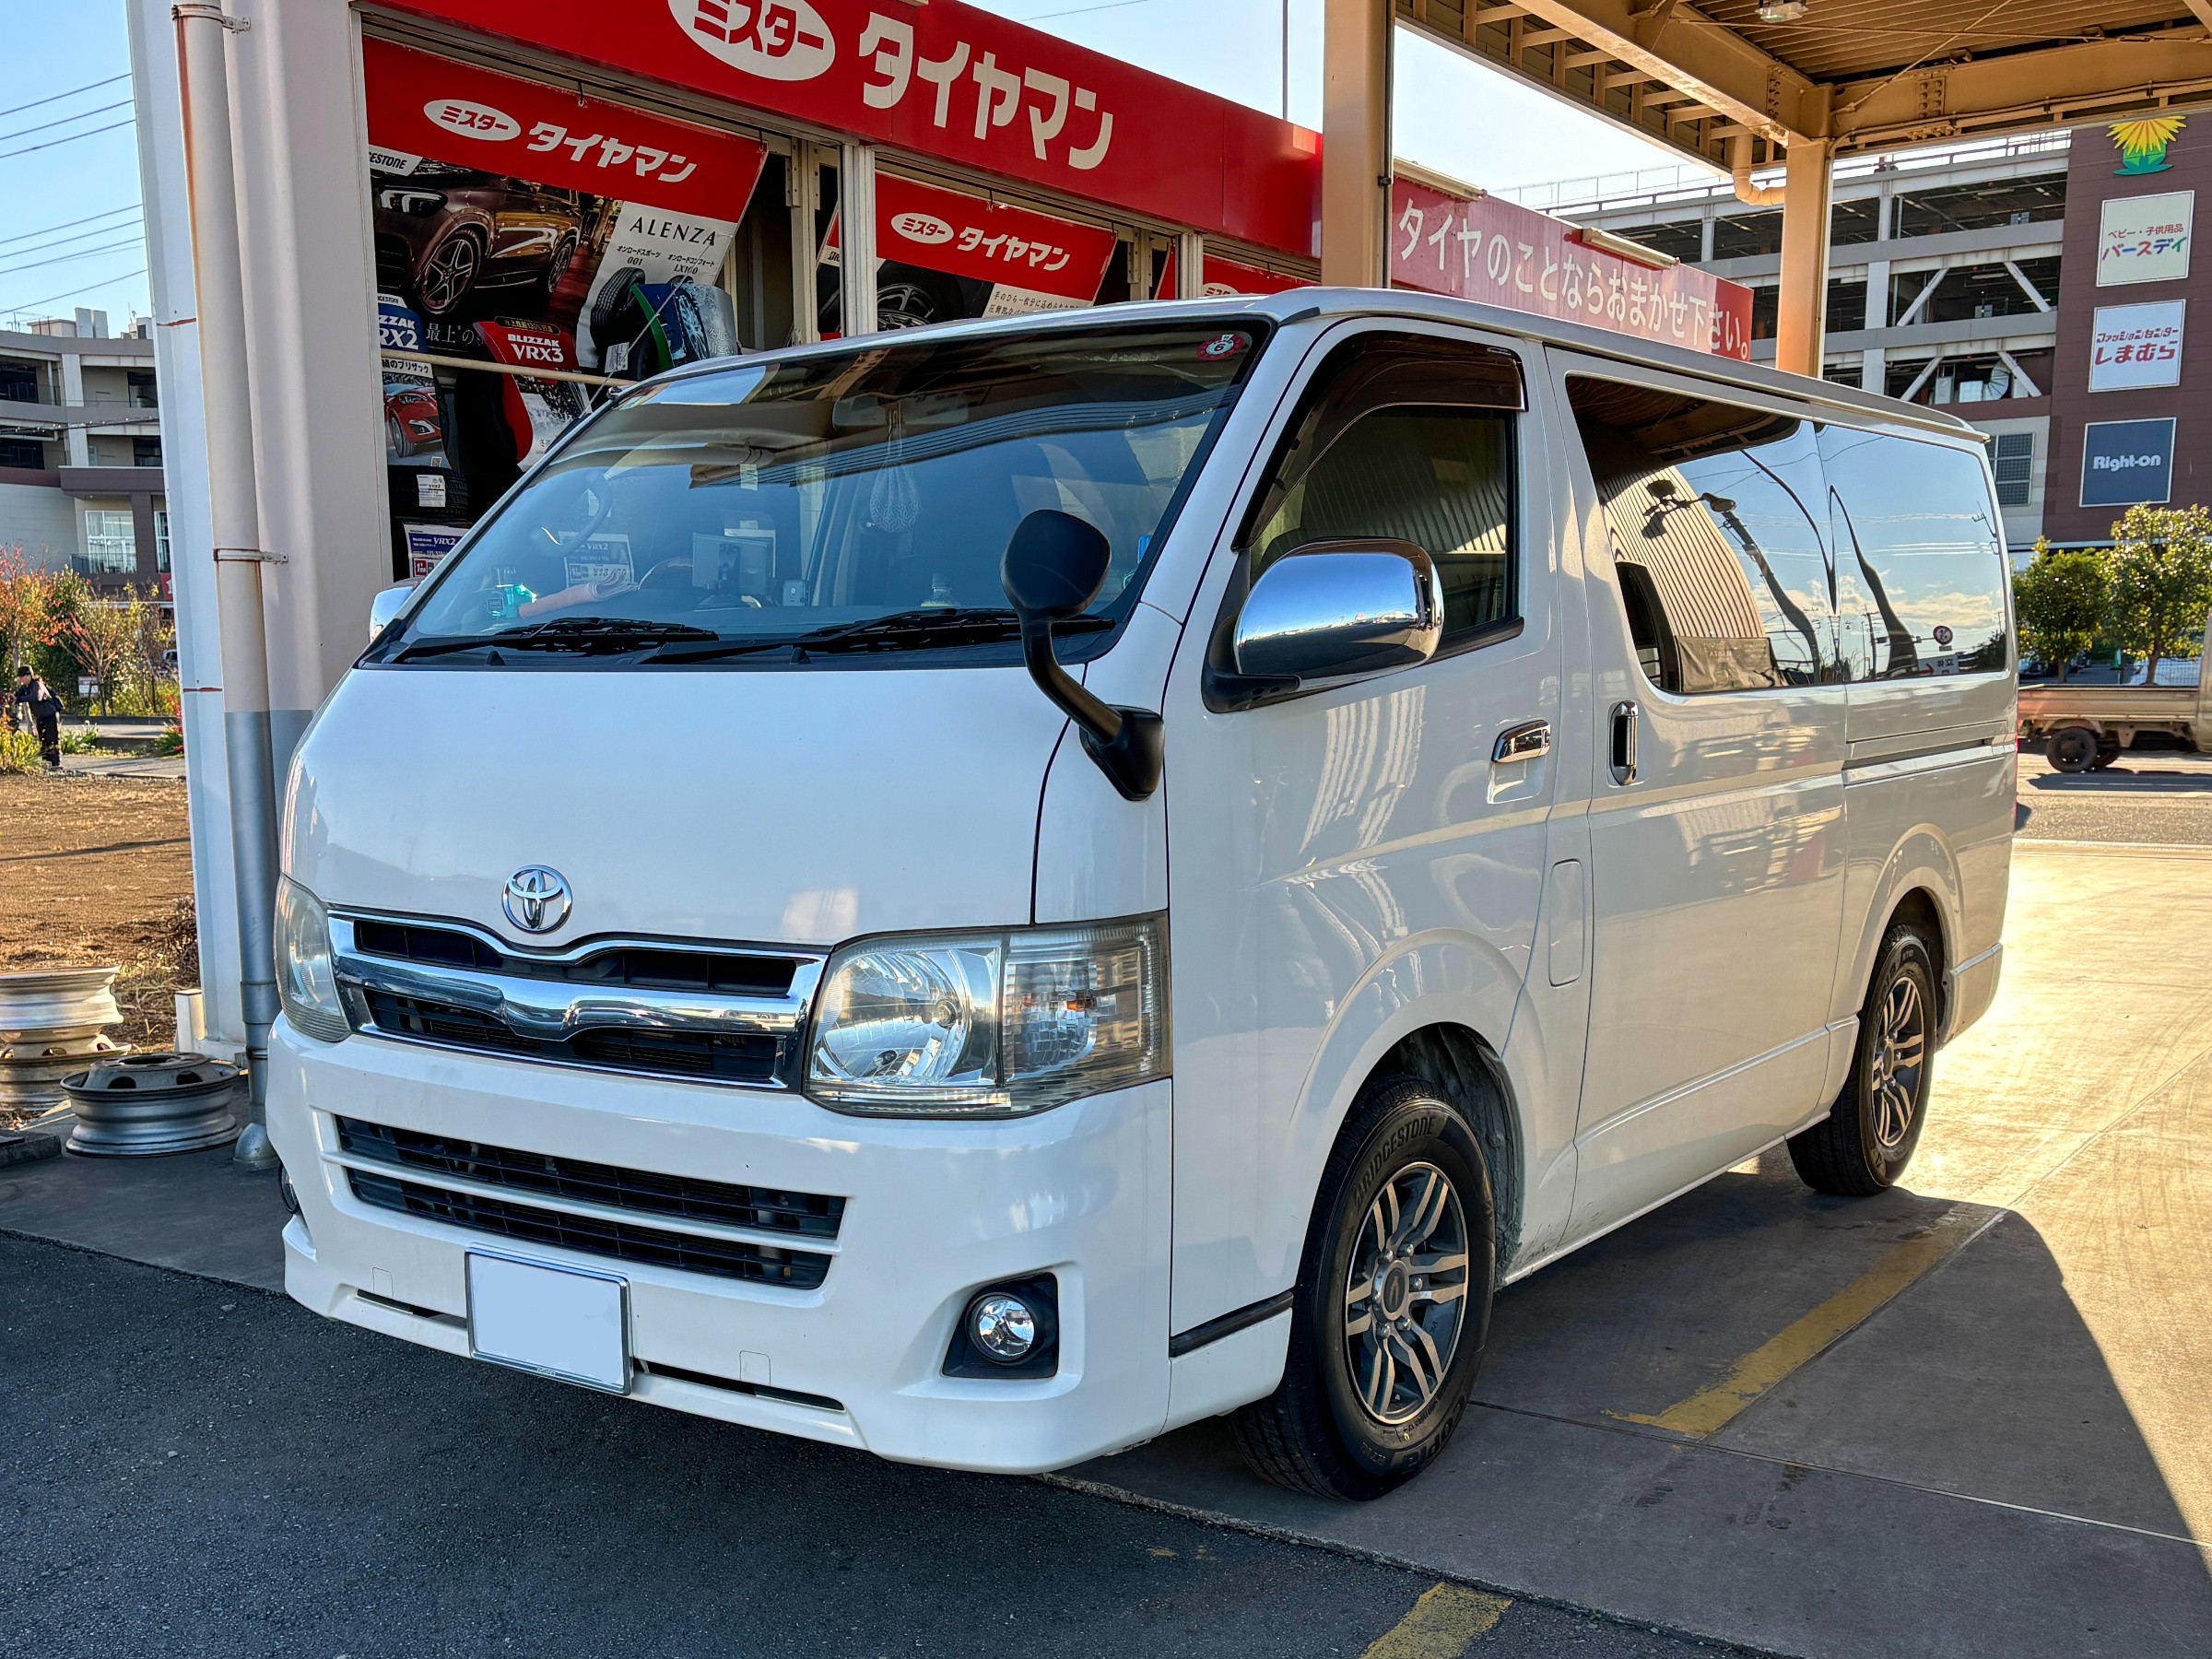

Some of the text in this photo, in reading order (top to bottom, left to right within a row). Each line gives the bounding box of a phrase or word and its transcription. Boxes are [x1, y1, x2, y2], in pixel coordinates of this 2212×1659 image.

[694, 0, 1113, 170] ミスター タイヤマン
[440, 105, 698, 182] ミスター タイヤマン
[629, 216, 716, 246] ALENZA
[2108, 223, 2184, 239] ベビー・子供用品
[617, 245, 715, 267] オンロードスポーツ オンロードコンフォート
[901, 217, 1071, 271] ミスター タイヤマン
[2101, 236, 2187, 261] バースデイ
[627, 256, 643, 266] 001
[1398, 197, 1749, 360] タイヤのことならおまかせ下さい。
[507, 333, 560, 348] BLIZZAK
[2097, 326, 2180, 344] ファッションセンター
[510, 343, 565, 363] VRX3
[2094, 340, 2179, 366] しまむら
[1352, 1115, 1436, 1215] BRIDGESTONE
